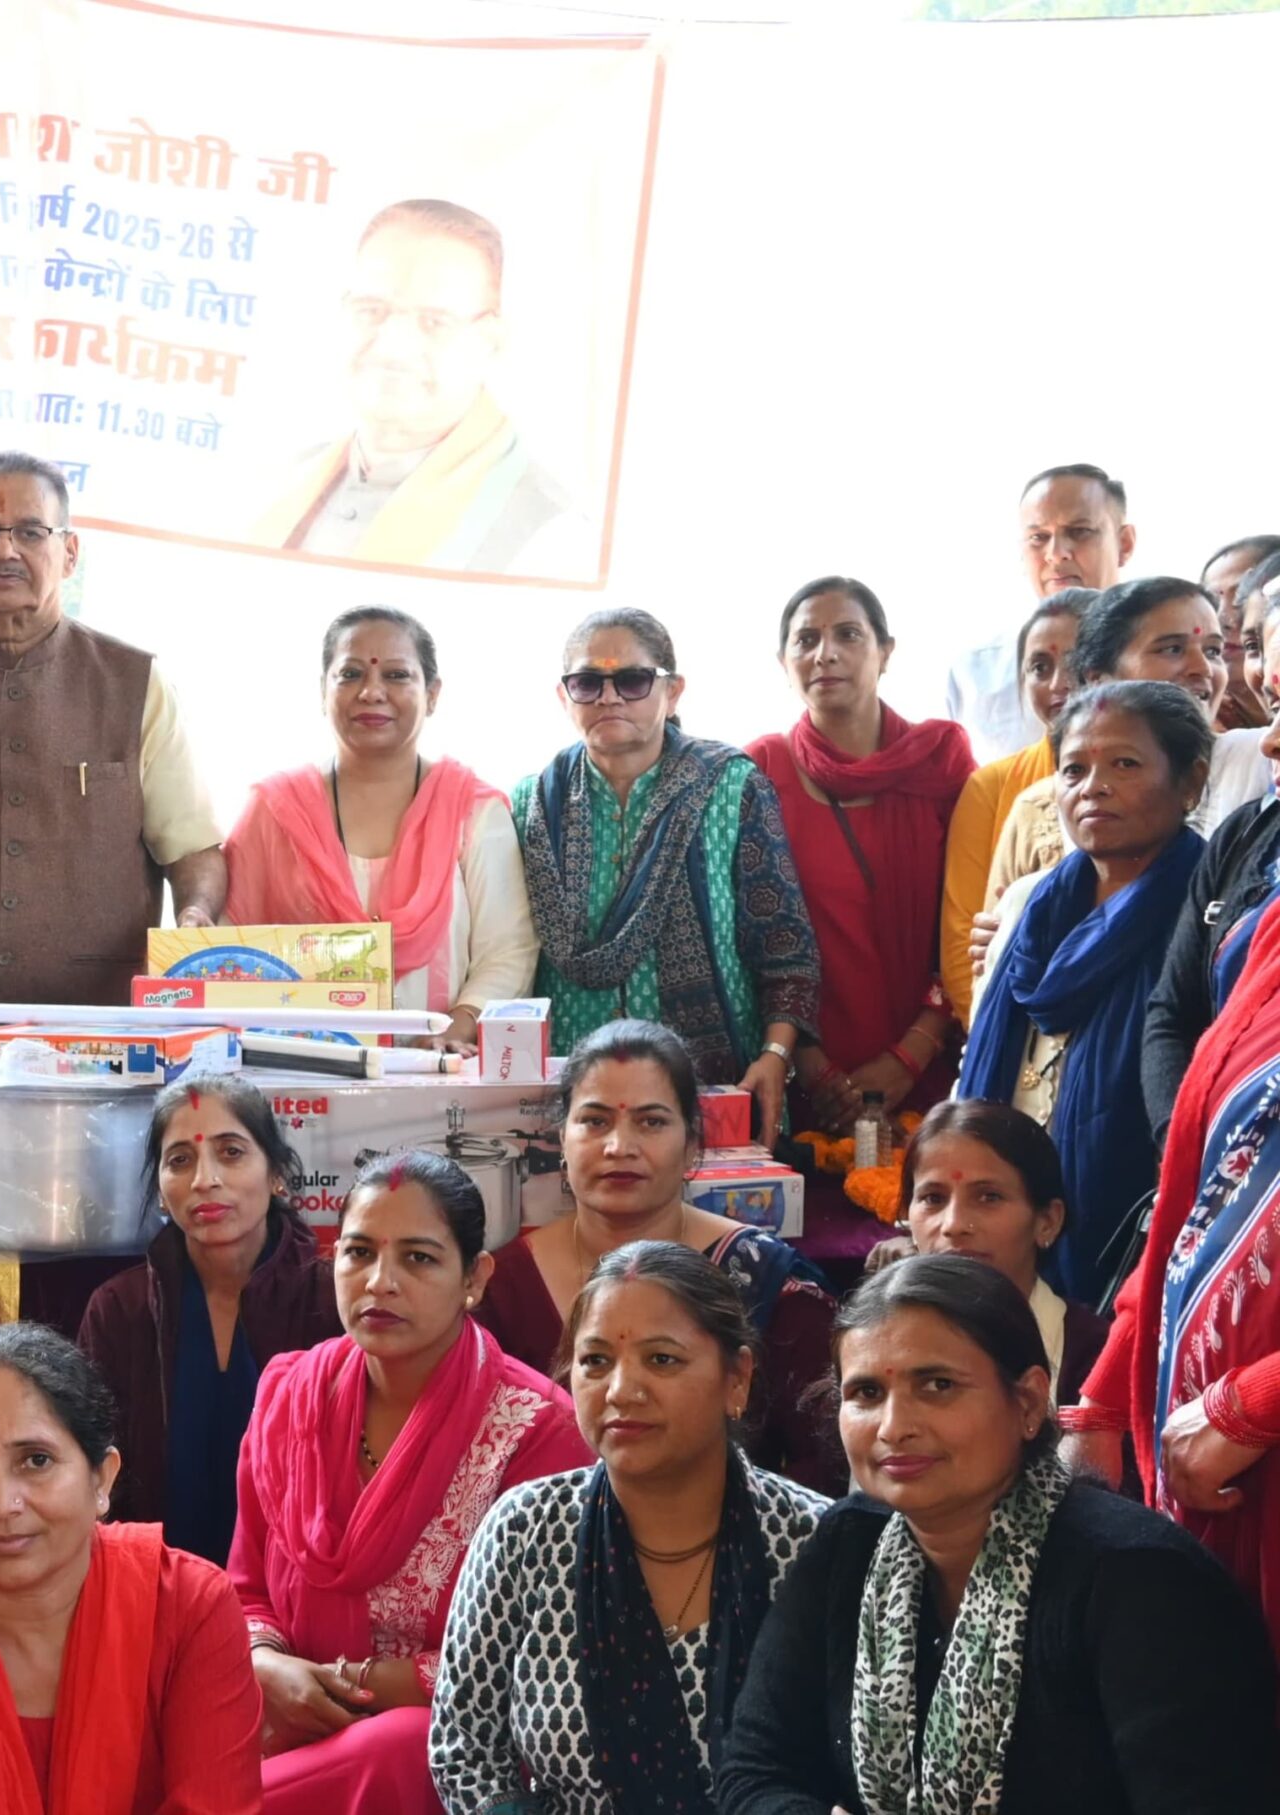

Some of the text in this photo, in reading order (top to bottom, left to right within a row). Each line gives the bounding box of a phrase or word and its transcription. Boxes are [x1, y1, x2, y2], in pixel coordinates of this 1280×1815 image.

[94, 117, 239, 190] जोशी
[257, 151, 338, 204] जी
[82, 202, 214, 260] 2025-26
[228, 215, 259, 262] से
[44, 247, 132, 302] केन्द्रों
[140, 271, 176, 311] के
[185, 277, 257, 328] लिए
[97, 400, 164, 441] 11.30
[176, 412, 223, 450] बजे
[145, 988, 193, 1004] Magnetic
[274, 1096, 328, 1115] ited
[291, 1170, 339, 1191] gular
